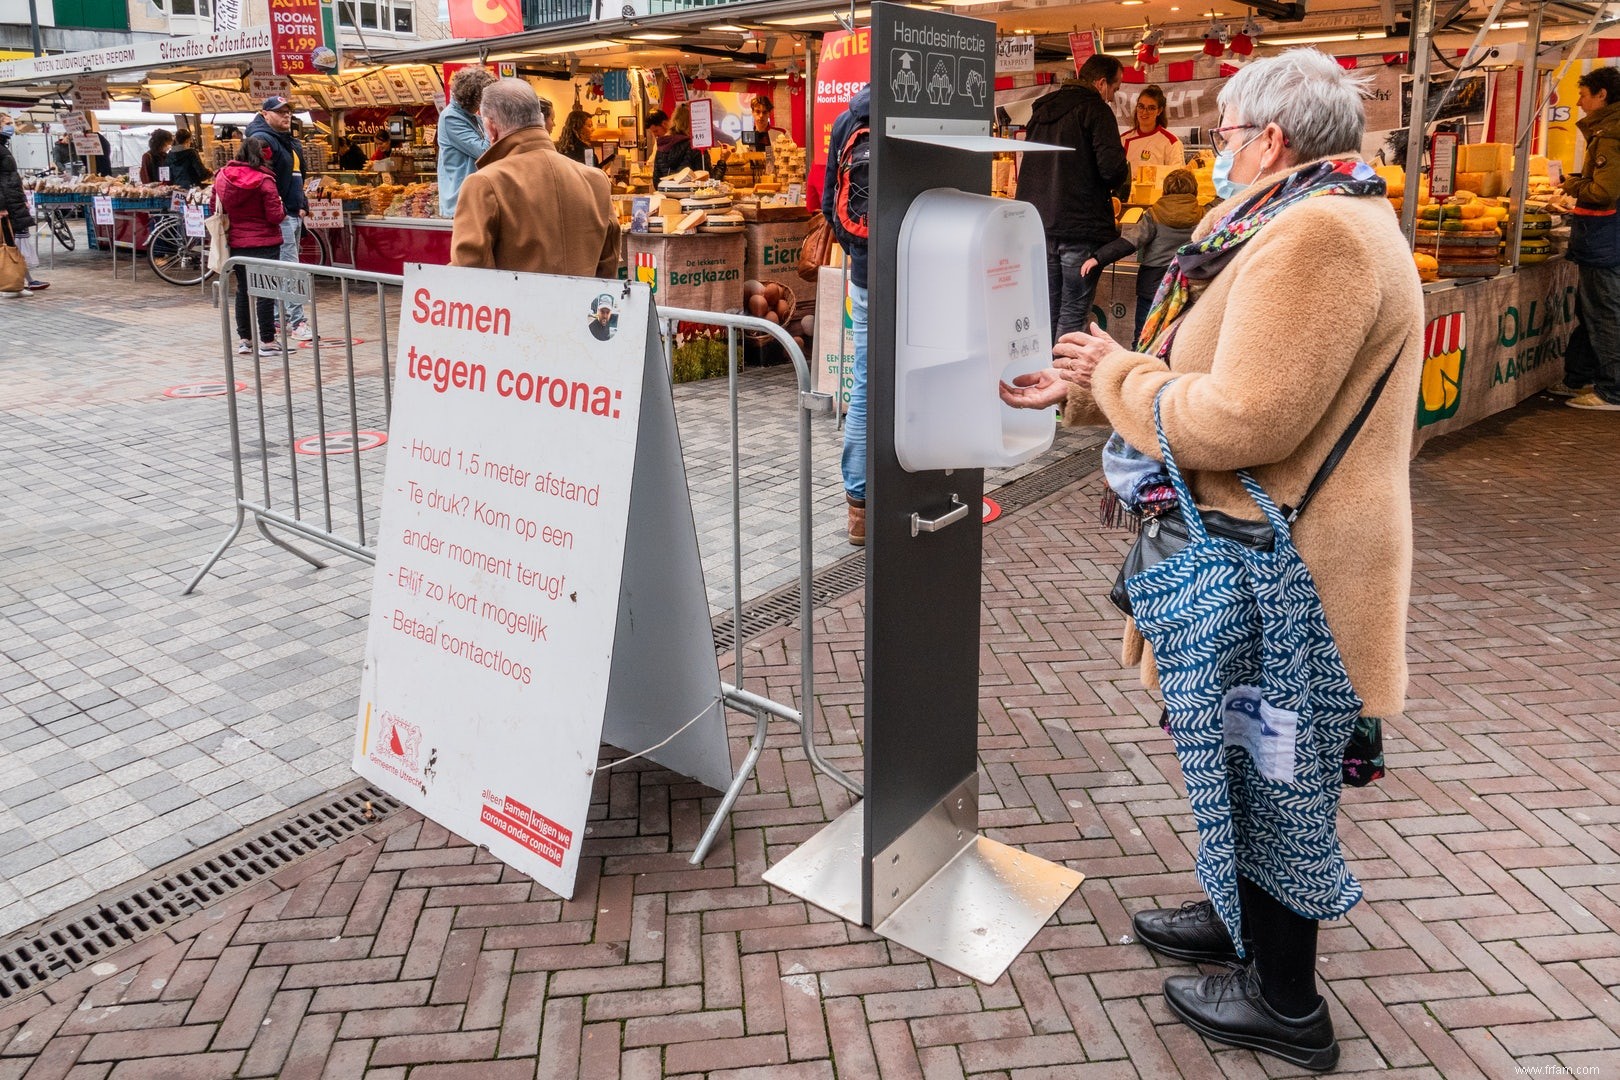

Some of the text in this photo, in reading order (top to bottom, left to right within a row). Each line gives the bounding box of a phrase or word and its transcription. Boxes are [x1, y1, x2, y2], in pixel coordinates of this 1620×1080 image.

[273, 11, 318, 24] ROOM-
[277, 24, 317, 36] BOTER
[159, 40, 204, 60] Utrechtse
[287, 37, 317, 52] 1,99
[821, 32, 870, 64] ACTIE
[893, 21, 986, 53] Handdesinfectie
[1004, 38, 1034, 58] Trappe
[33, 48, 136, 73] NOTEN ZUIDVRUCHTEN REFORM
[281, 60, 305, 71] 3,50
[999, 58, 1028, 67] TRAPPIST
[816, 92, 853, 105] Noord Holl
[686, 257, 727, 268] De lekkerste
[669, 267, 740, 288] Bergkazen
[411, 287, 511, 337] Samen
[407, 344, 623, 419] tegen corona:
[411, 438, 451, 468] Houd
[457, 450, 480, 476] 1,5
[484, 460, 531, 489] meter
[535, 472, 601, 507] afstand
[407, 480, 424, 505] Te
[427, 488, 471, 518] druk?
[473, 503, 511, 531] Kom
[515, 517, 537, 543] op
[542, 525, 574, 551] een
[402, 527, 566, 602] ander moment terug!
[425, 581, 444, 602] zo
[447, 584, 477, 616] kort
[481, 601, 549, 643] mogelijk
[392, 608, 438, 647] Betaal
[440, 631, 533, 686] contactloos
[369, 751, 400, 778] Gemeente
[481, 787, 571, 846] alleen samen krijgen we
[481, 808, 508, 831] corona
[507, 821, 530, 844] onder
